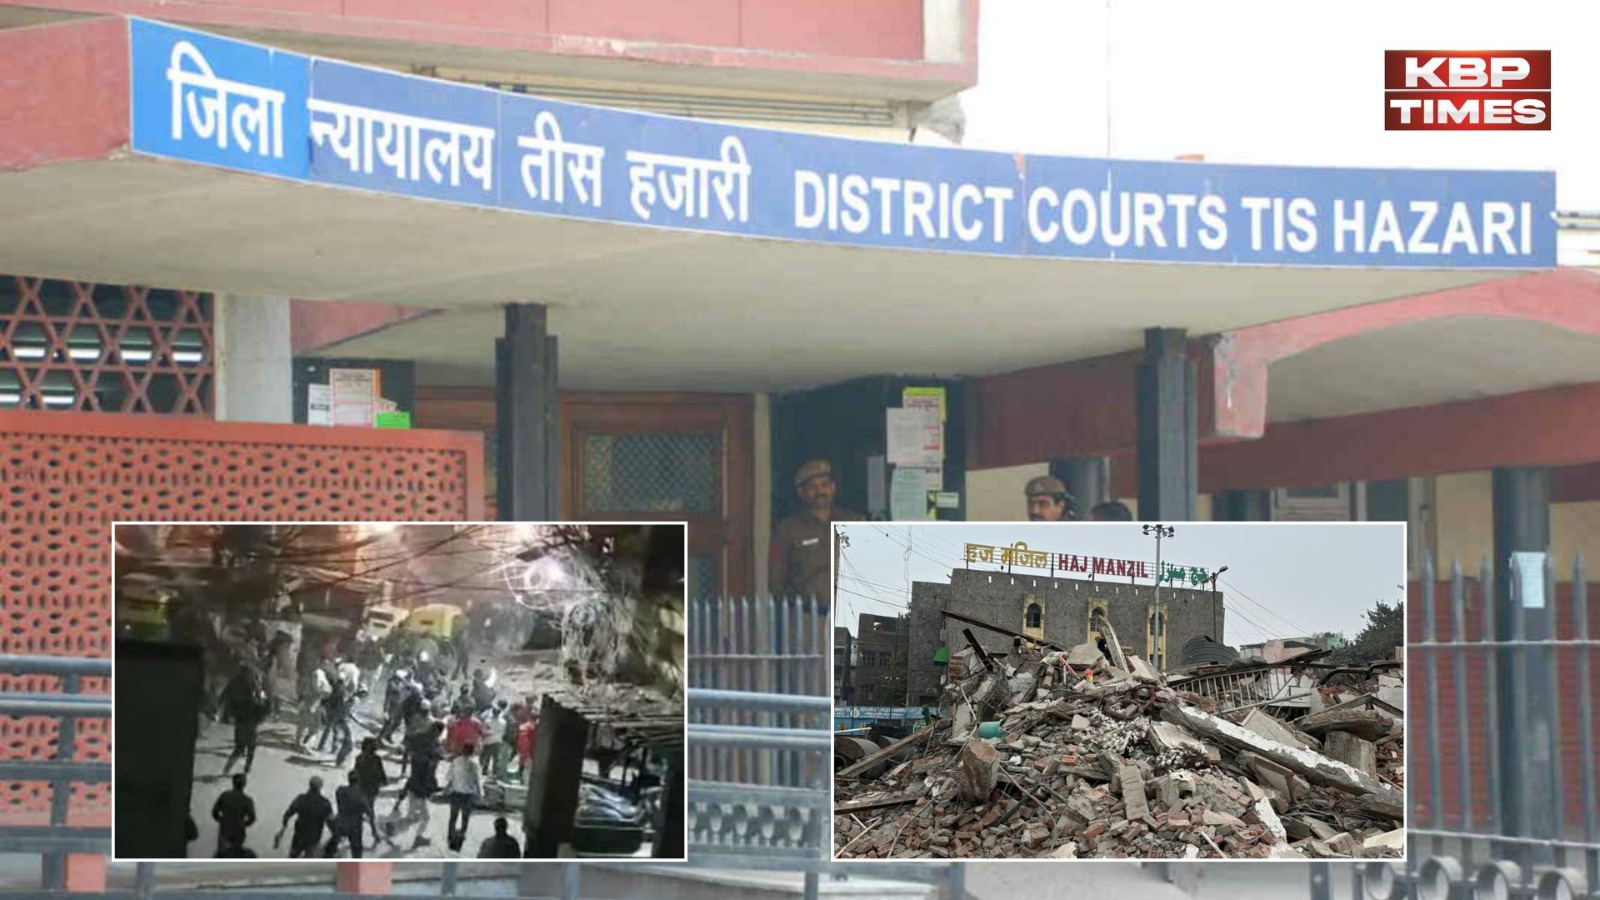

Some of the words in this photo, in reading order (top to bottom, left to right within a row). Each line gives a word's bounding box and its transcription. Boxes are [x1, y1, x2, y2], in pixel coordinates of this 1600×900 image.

[166, 40, 285, 158] जिला
[306, 98, 495, 191] न्यायालय
[517, 110, 605, 207] तीस
[625, 135, 751, 223] हजारी
[794, 169, 1014, 243] DISTRICT
[1027, 185, 1228, 251] COURTS
[1241, 195, 1319, 253] TIS
[1333, 199, 1532, 256] HAZARI
[966, 543, 995, 563] हज
[1058, 553, 1088, 572] HAJ
[1092, 556, 1149, 578] MANZIL
